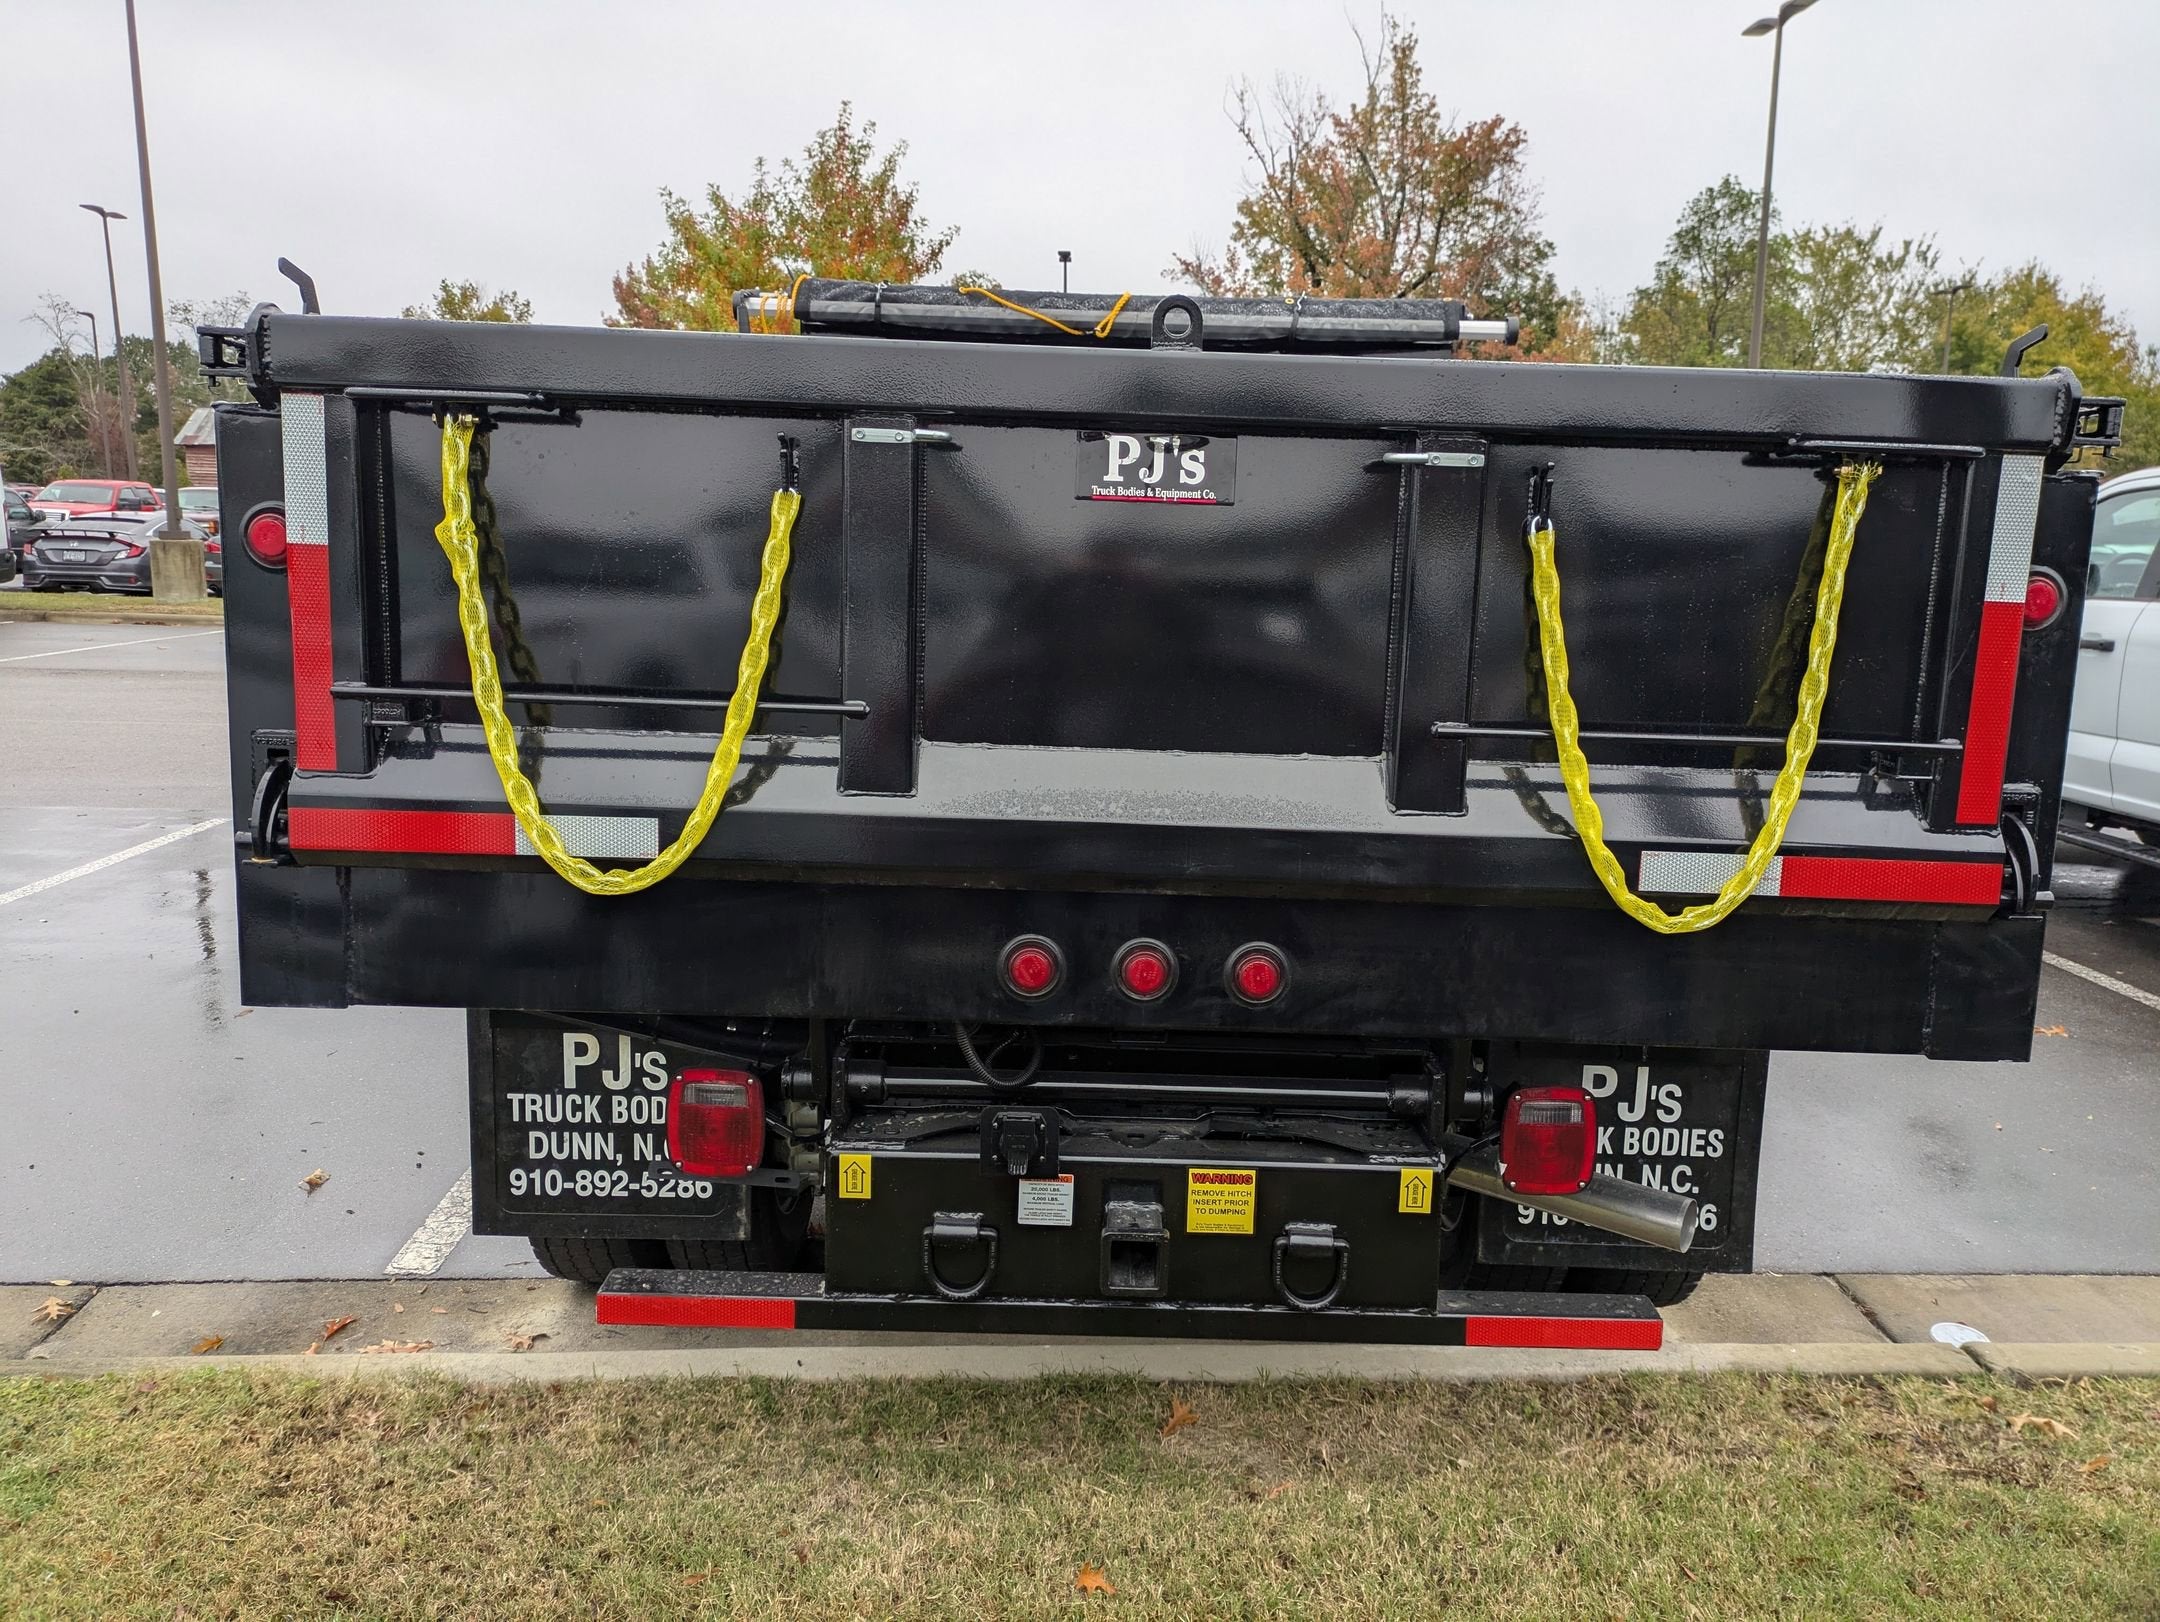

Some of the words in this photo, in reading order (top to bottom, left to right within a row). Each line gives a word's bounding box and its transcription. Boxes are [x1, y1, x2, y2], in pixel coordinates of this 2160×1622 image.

[1103, 434, 1206, 485] PJ's
[1091, 485, 1116, 496] Truck
[1117, 487, 1145, 497] Bodies
[1146, 488, 1154, 497] &
[1155, 488, 1202, 501] Equipment
[1202, 489, 1217, 500] Co.
[507, 1093, 601, 1124] TRUCK
[612, 1095, 667, 1125] BOD
[529, 1131, 623, 1166] DUNN,
[1623, 1126, 1725, 1158] BODIES
[509, 1168, 713, 1199] 910-892-5286
[1191, 1172, 1254, 1186] WARNING
[1191, 1189, 1226, 1197] REMOVE
[1227, 1190, 1252, 1198] HITCH
[1641, 1164, 1699, 1194] N.C.
[1192, 1198, 1222, 1206] INSERT
[1224, 1199, 1250, 1207] PRIOR
[1195, 1207, 1207, 1215] TO
[1208, 1208, 1246, 1216] DUMPING
